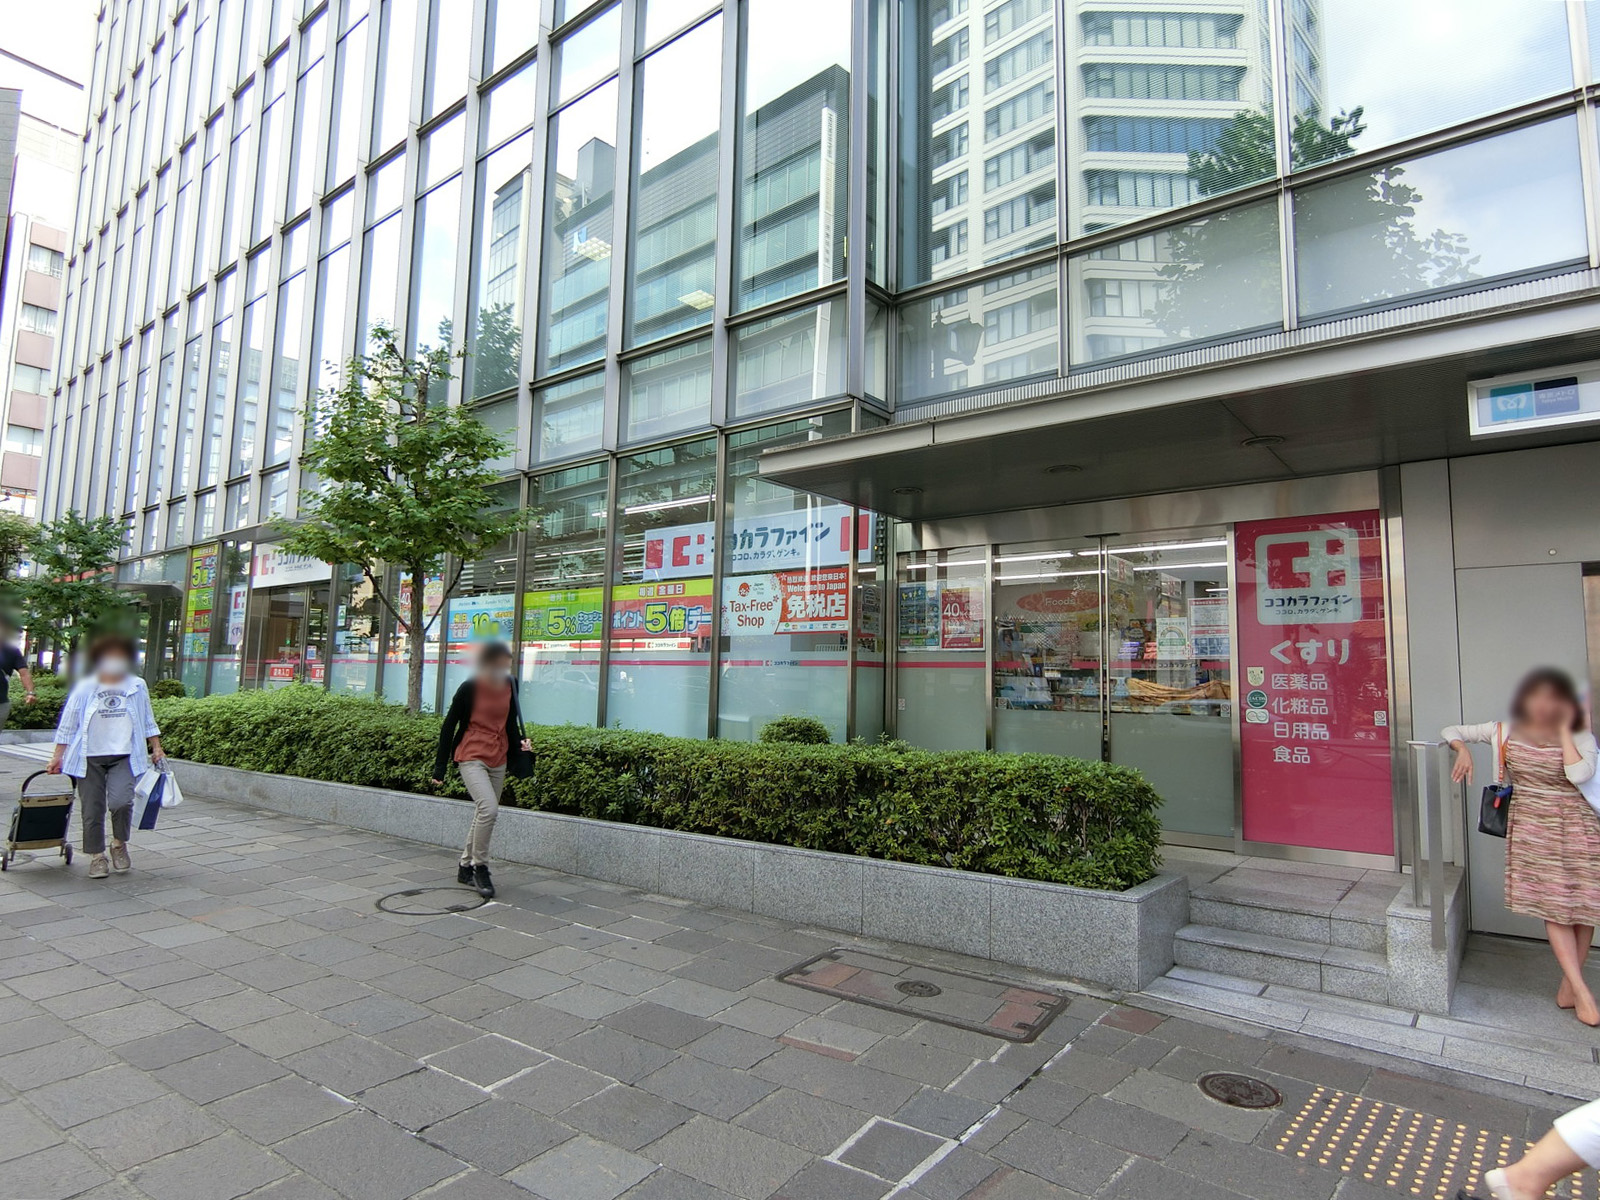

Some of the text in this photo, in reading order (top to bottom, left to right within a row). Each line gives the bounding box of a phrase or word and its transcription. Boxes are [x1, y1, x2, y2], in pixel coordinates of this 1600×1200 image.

[827, 582, 846, 591] Japan
[730, 600, 773, 612] Tax-Free
[787, 592, 846, 619] 免税店
[1045, 596, 1076, 606] Foods
[1264, 595, 1353, 607] ココカラファイン
[737, 614, 765, 628] Shop
[1270, 639, 1350, 665] くすり
[1271, 673, 1328, 691] 医薬品
[1271, 697, 1329, 715] 化粧品
[1273, 721, 1330, 740] 日用品
[1273, 746, 1311, 764] 食品
